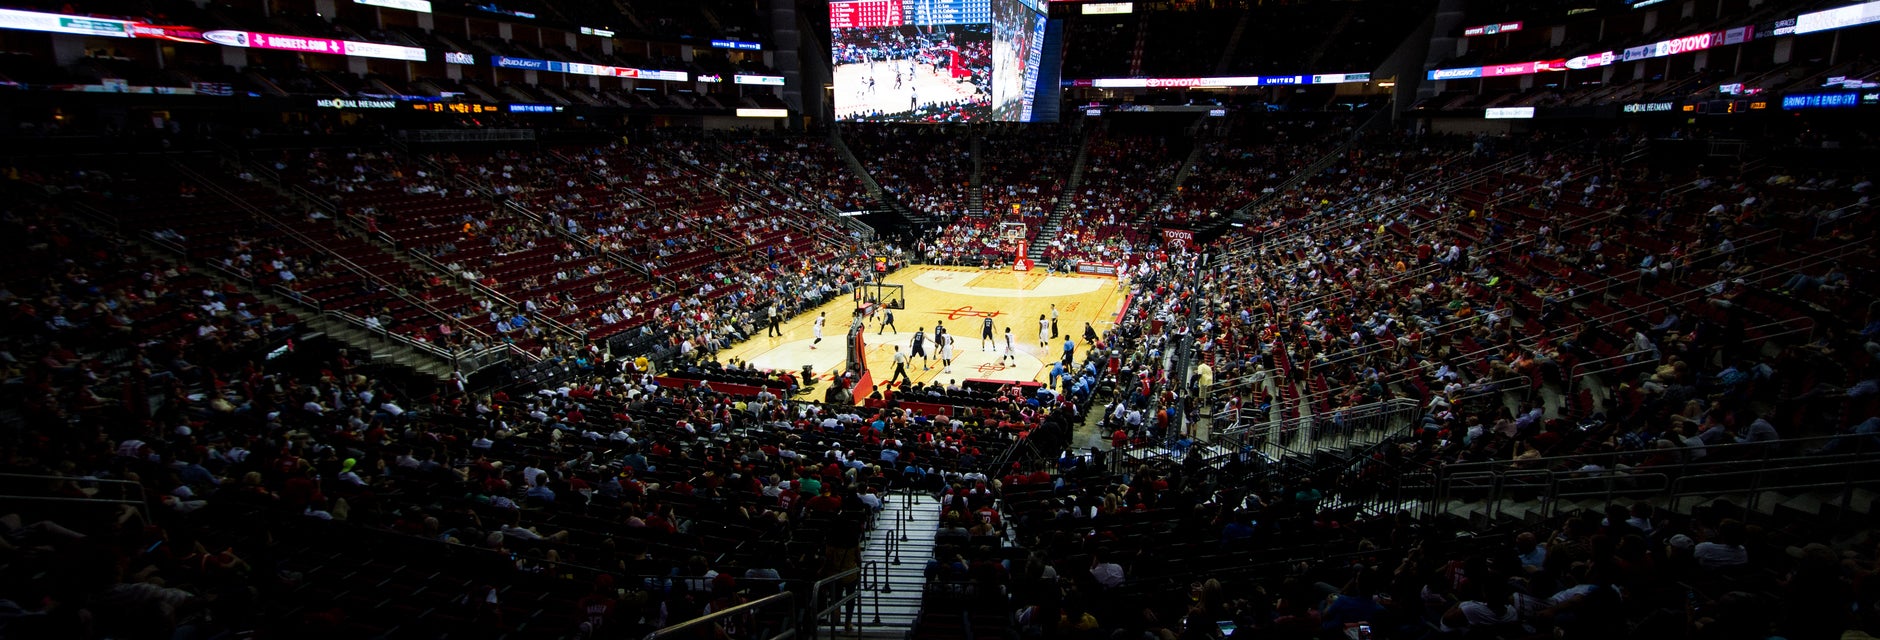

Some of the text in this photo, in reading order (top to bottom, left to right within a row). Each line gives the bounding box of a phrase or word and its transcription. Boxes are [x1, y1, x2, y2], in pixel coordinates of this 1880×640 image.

[268, 36, 328, 51] ROCKETS.COM
[1681, 33, 1723, 52] TOYOTA
[502, 57, 541, 68] BUD LIGHT
[1453, 69, 1476, 77] LIGHT
[317, 99, 396, 109] MEMORIAL HERMANN
[1783, 94, 1856, 107] BRING THE ENERGY!
[1623, 103, 1646, 112] MEMORIAL
[1647, 102, 1673, 111] HERMANN
[1164, 230, 1192, 240] TOYOTA
